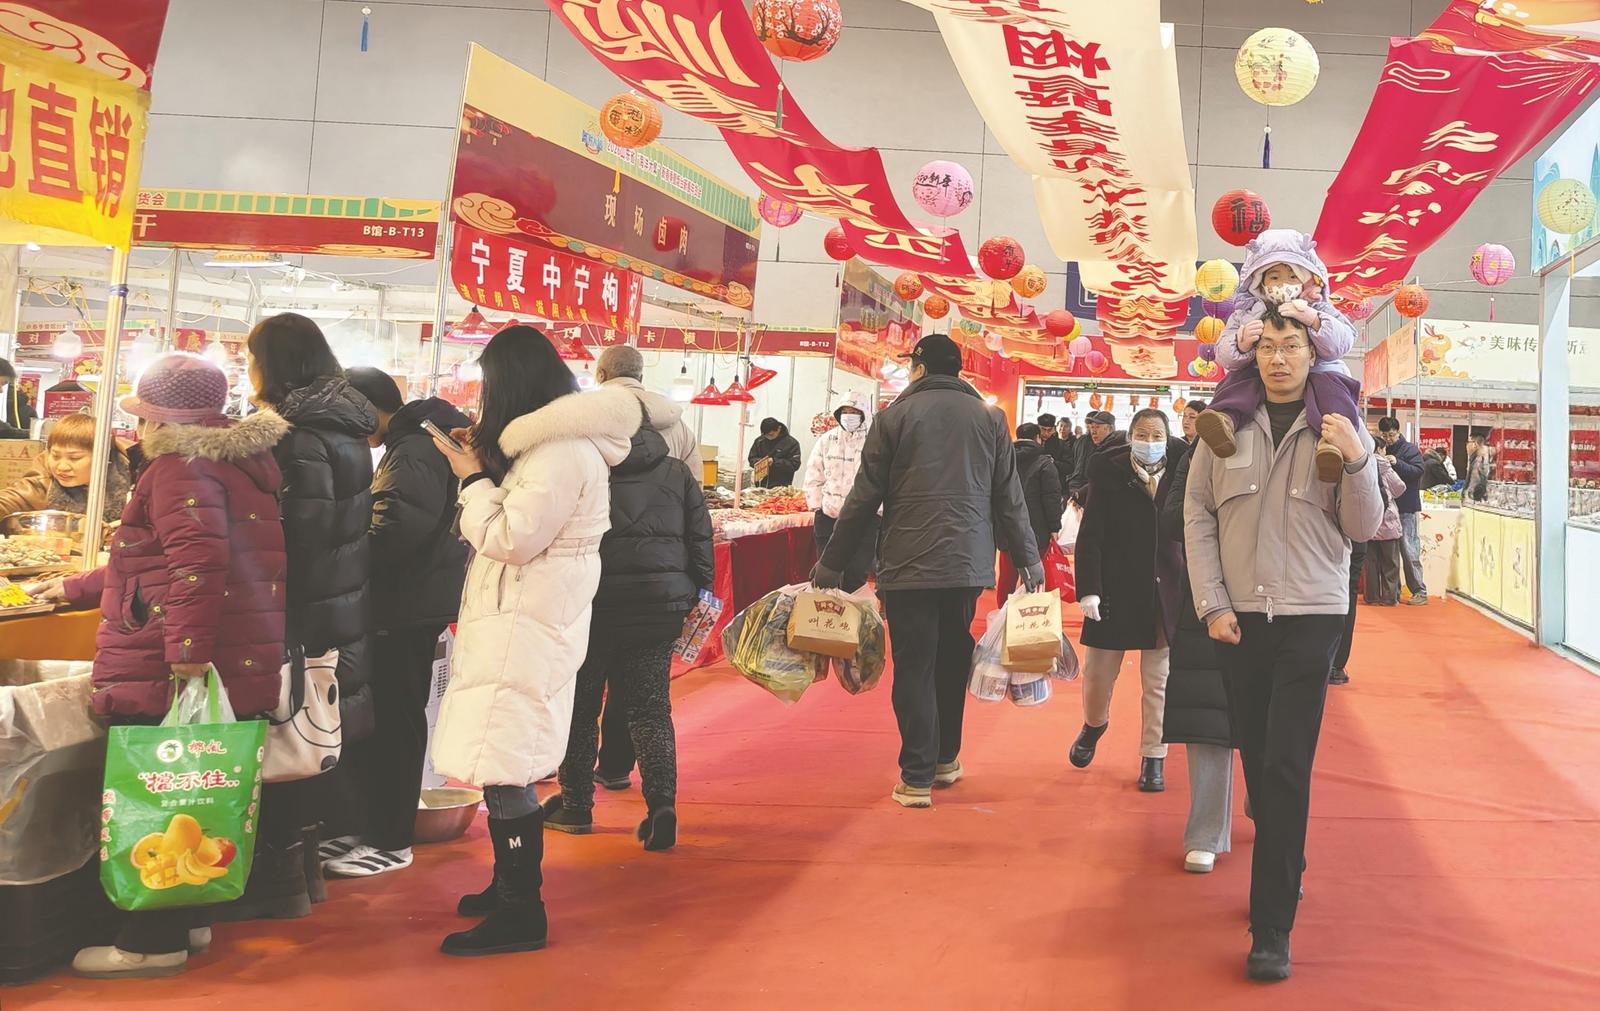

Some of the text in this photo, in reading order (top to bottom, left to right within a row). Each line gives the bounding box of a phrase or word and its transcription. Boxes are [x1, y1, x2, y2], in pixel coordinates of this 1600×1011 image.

[137, 191, 165, 207] 货会
[1231, 197, 1266, 233] 福
[363, 225, 425, 238] B馆-B-T13
[603, 194, 689, 256] 现场卤肉
[508, 836, 522, 849] M
